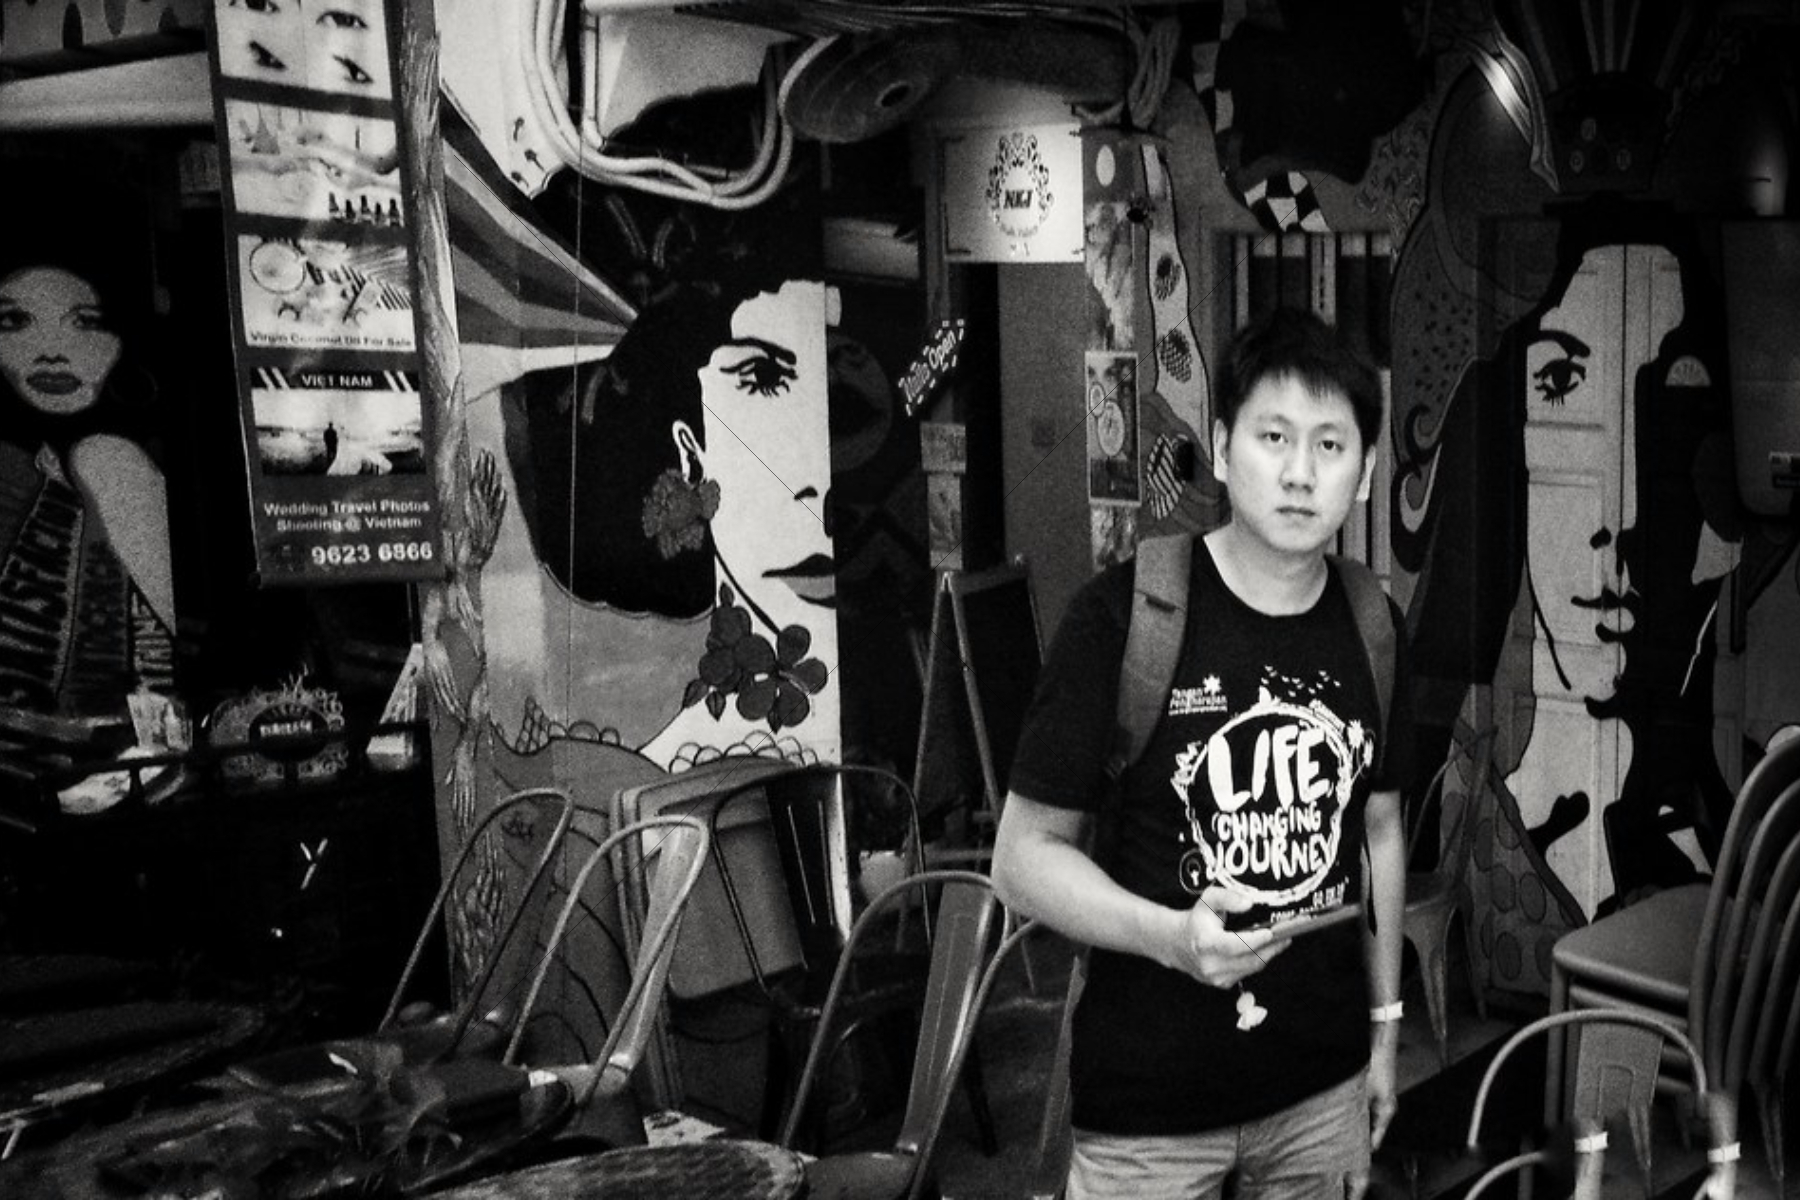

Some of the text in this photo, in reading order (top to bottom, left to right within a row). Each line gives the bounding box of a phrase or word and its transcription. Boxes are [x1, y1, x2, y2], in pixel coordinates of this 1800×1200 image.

[387, 338, 411, 347] Sale
[929, 330, 956, 370] Open
[302, 374, 373, 387] VIET NAM
[264, 499, 430, 516] Wedding Travel Photos
[364, 517, 421, 529] Vietnam
[311, 543, 371, 565] 9623
[1207, 724, 1330, 812] LIFE
[1216, 802, 1321, 841] CHANGING
[1206, 833, 1331, 880] JOURNEY
